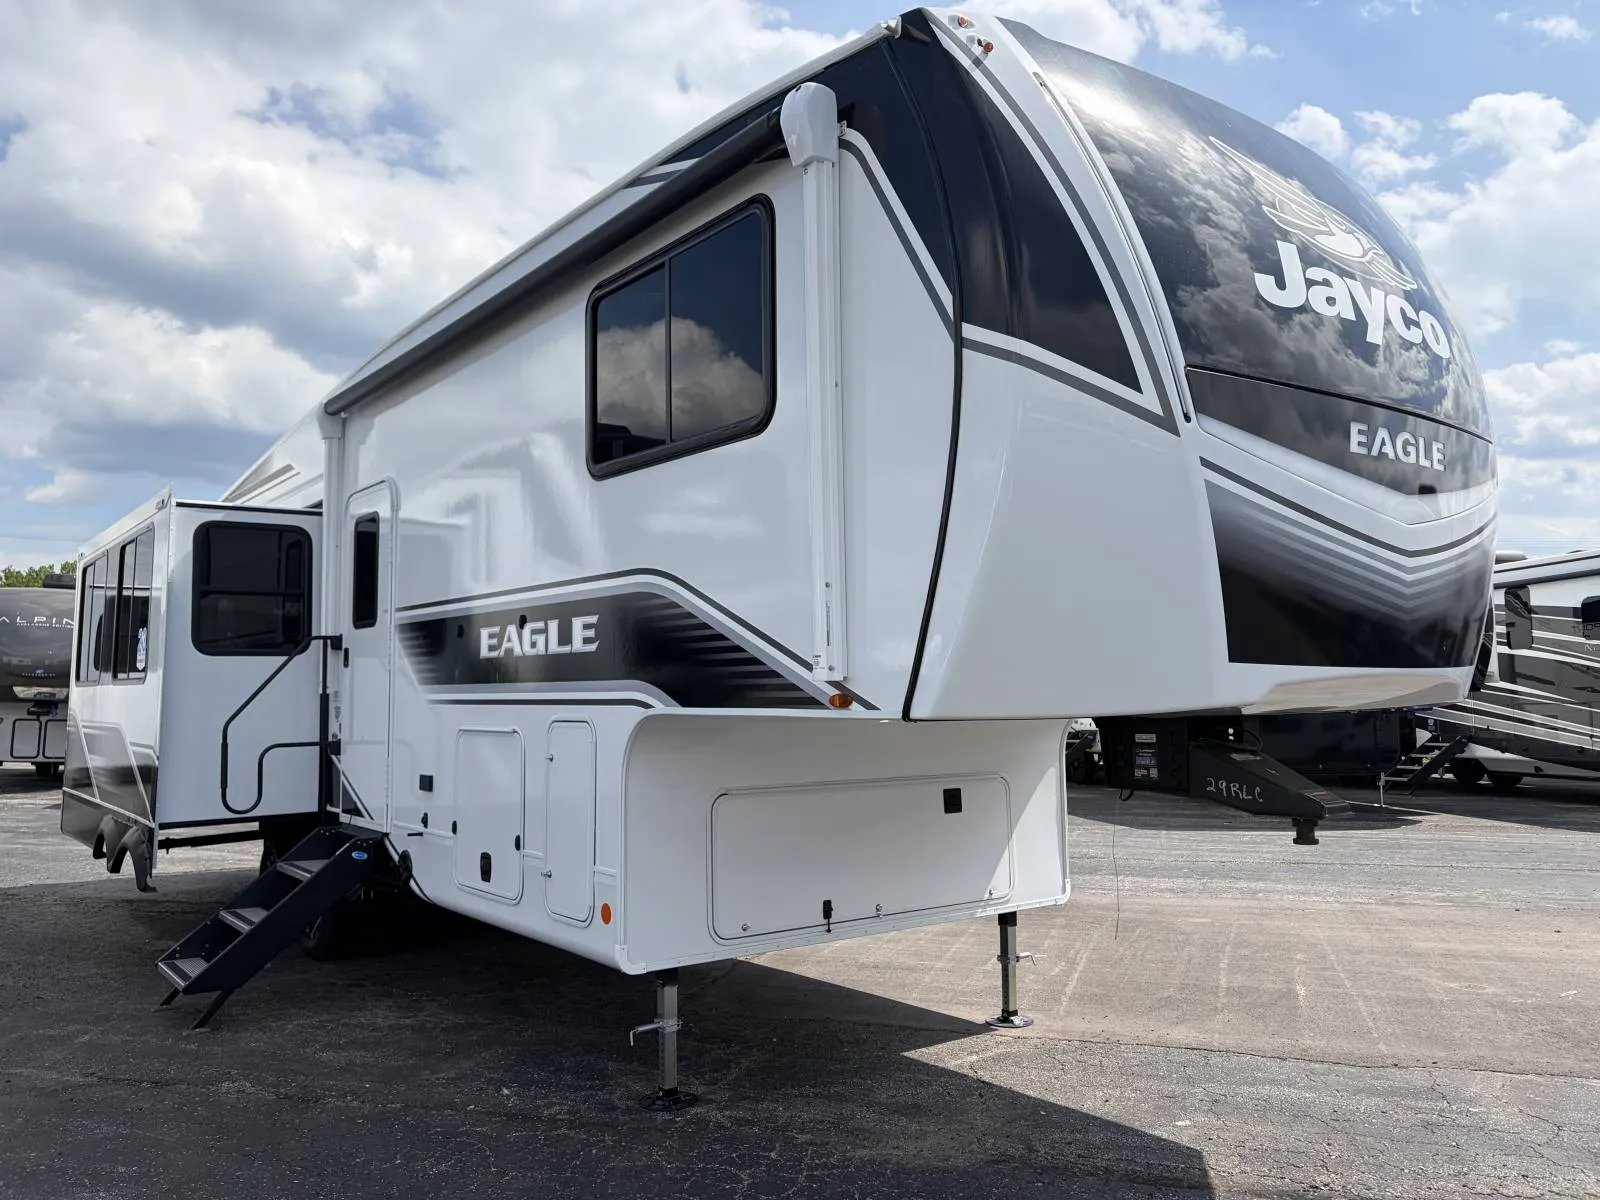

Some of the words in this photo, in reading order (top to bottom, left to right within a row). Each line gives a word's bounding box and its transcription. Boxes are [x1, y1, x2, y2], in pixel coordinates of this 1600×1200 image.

[1254, 240, 1450, 359] Jayco
[1350, 421, 1447, 472] EAGLE
[479, 614, 600, 660] EAGLE
[1206, 777, 1264, 803] 29RLC
